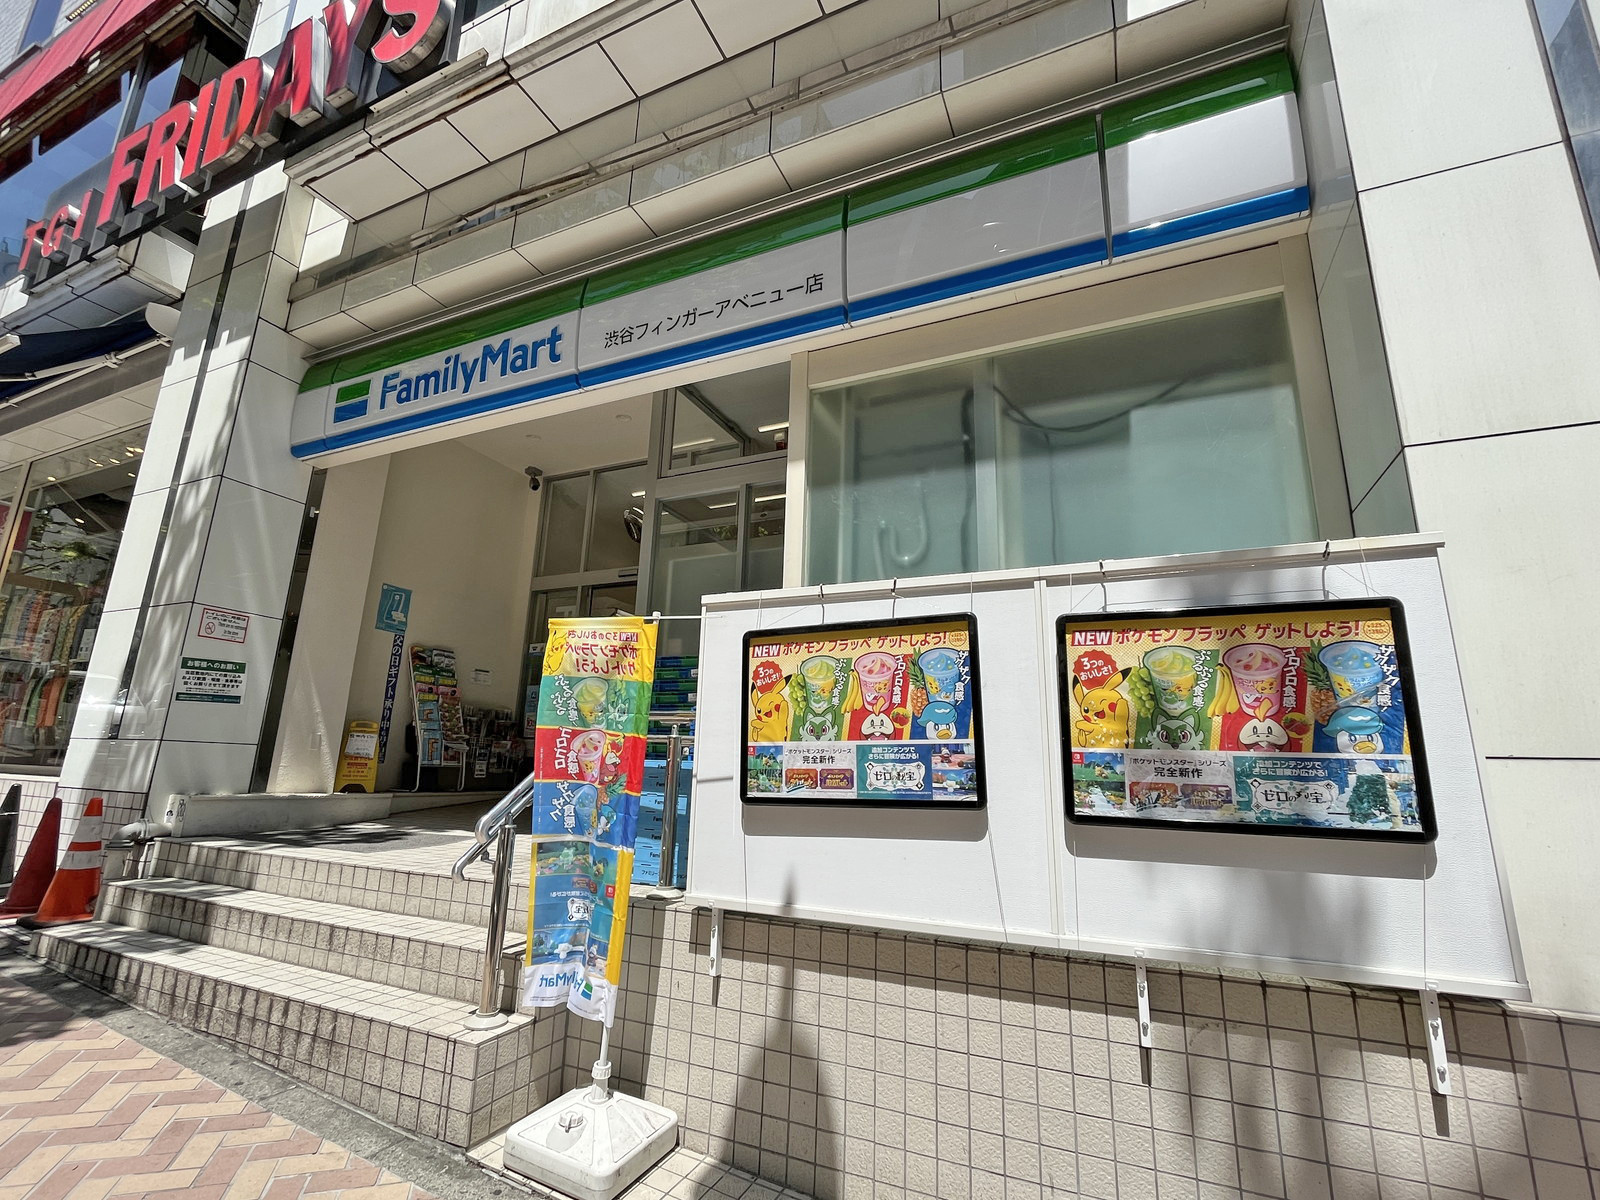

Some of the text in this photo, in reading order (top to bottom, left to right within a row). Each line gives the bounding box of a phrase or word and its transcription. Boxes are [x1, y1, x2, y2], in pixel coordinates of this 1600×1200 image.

[18, 188, 93, 272] TGI
[604, 273, 824, 349] 渋谷フィンガーアベニュー店
[379, 325, 564, 410] FamilyMart
[1073, 631, 1112, 645] NEW
[1254, 620, 1360, 640] ゲットしよう!
[753, 644, 780, 657] NEW
[877, 631, 947, 648] ゲットしよう!
[187, 660, 239, 670] お客様へのお願い
[1081, 657, 1104, 670] 3つの
[757, 667, 773, 677] 3つの
[1080, 666, 1113, 681] おいしさ!
[802, 755, 836, 765] 完全新作
[1154, 767, 1203, 779] 完全新作
